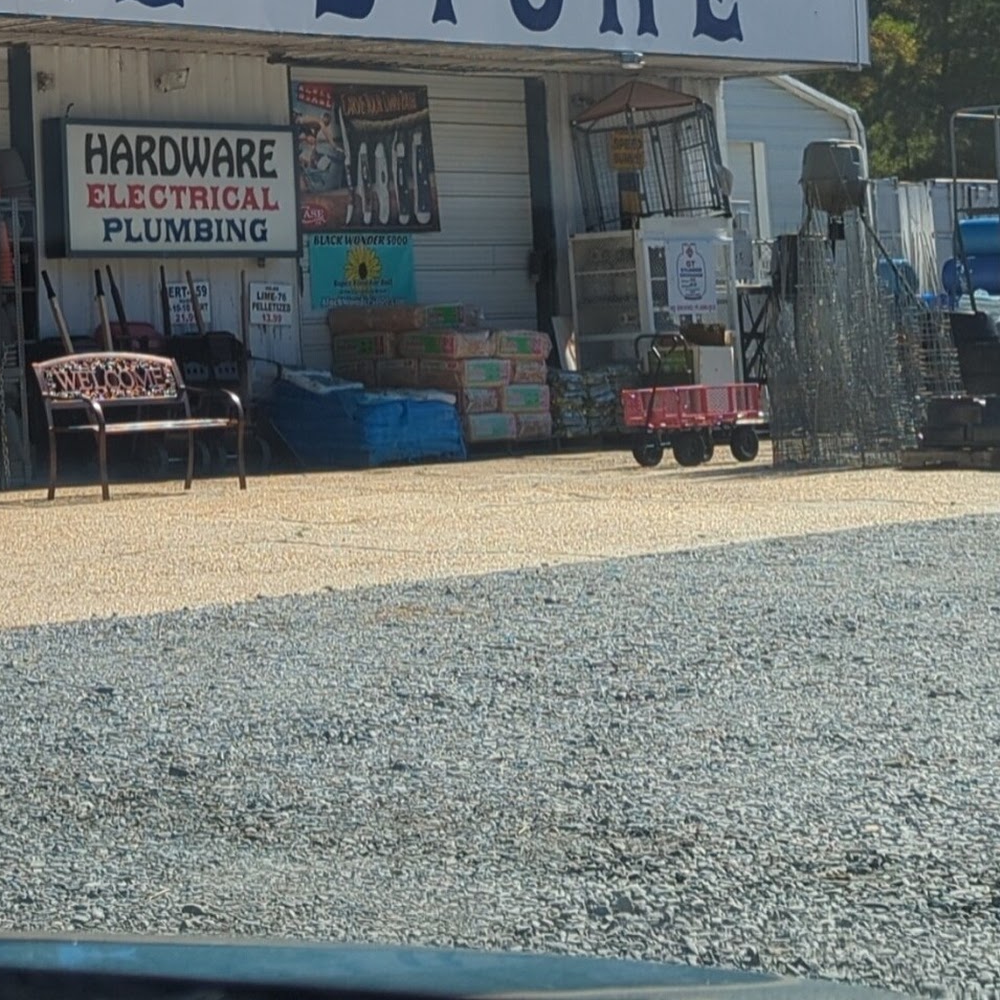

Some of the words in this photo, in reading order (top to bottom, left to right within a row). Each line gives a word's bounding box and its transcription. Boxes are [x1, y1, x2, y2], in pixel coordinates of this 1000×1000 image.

[85, 133, 278, 178] HARDWARE
[86, 183, 280, 212] ELECTRICAL
[102, 217, 268, 243] PLUMBING
[313, 235, 343, 246] BLACK
[345, 235, 385, 246] WONDER
[252, 302, 291, 313] PELLETIZED
[52, 366, 164, 391] WELCOME
